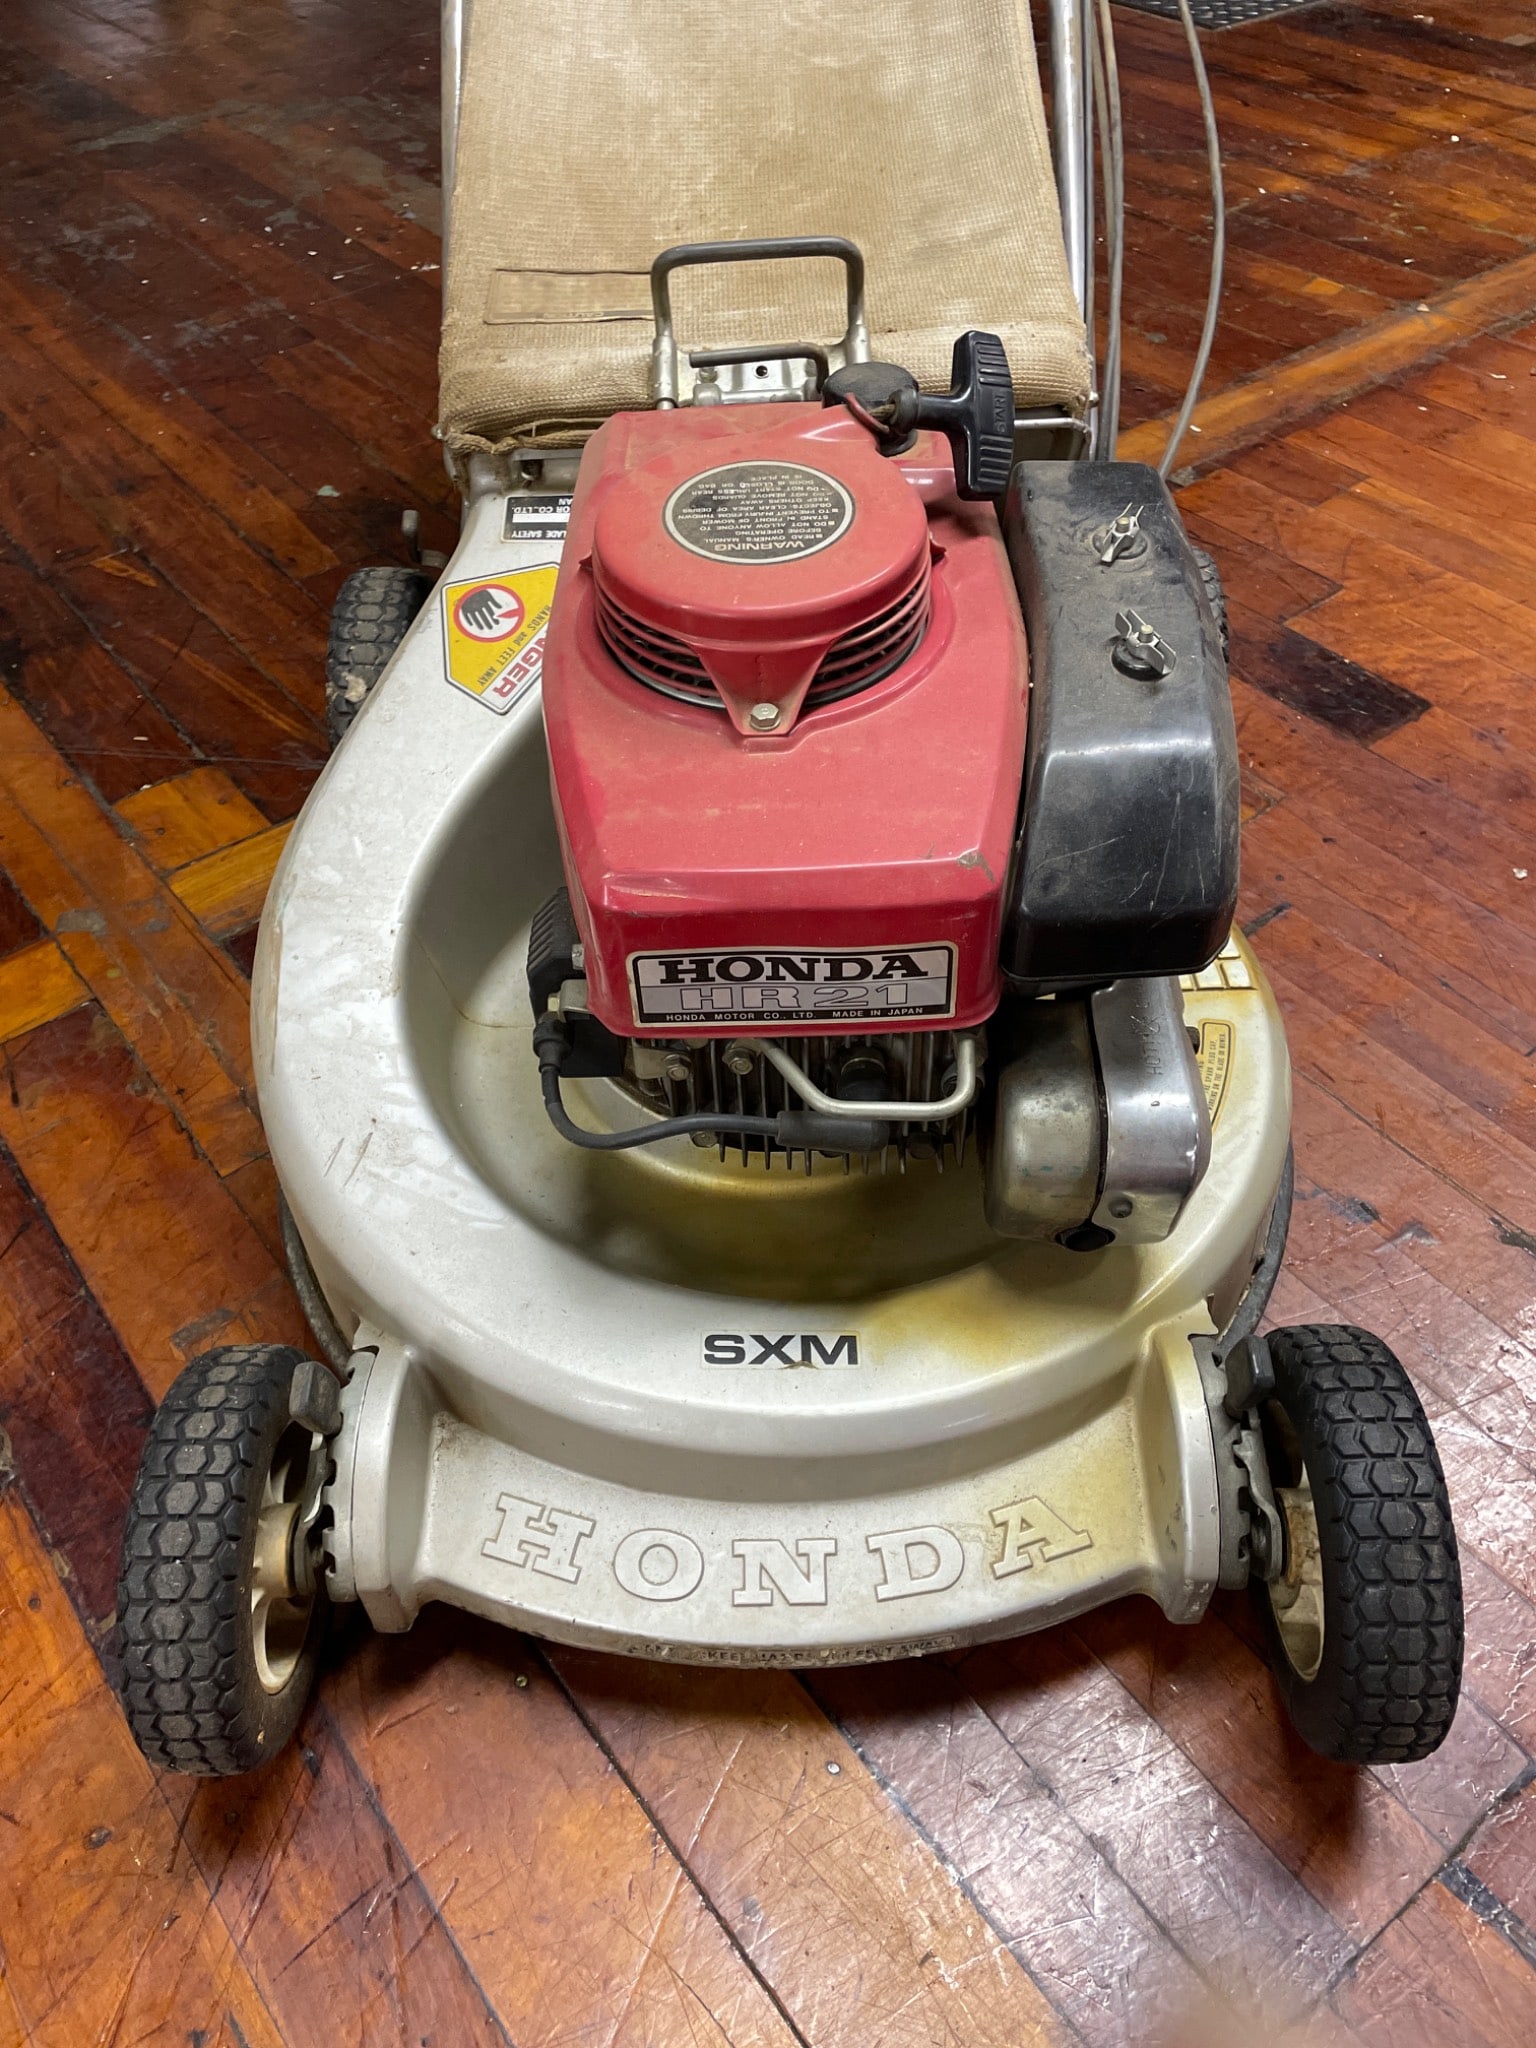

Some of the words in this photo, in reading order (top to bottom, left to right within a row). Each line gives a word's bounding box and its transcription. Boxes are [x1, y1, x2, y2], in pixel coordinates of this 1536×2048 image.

[512, 530, 542, 538] SAFETY
[546, 530, 567, 538] LADE
[715, 540, 805, 552] WARNING
[513, 631, 528, 645] and
[496, 647, 516, 666] FEET
[476, 666, 498, 686] AWAY
[492, 638, 546, 698] NGER
[658, 954, 928, 984] HONDA
[666, 1013, 706, 1021] HONDA
[714, 1012, 755, 1020] MOTOR
[792, 1011, 817, 1019] LTD.
[832, 1010, 864, 1018] MADE
[888, 1007, 924, 1016] JAPAN
[702, 1334, 860, 1366] SXM
[480, 1492, 1094, 1608] HONDA
